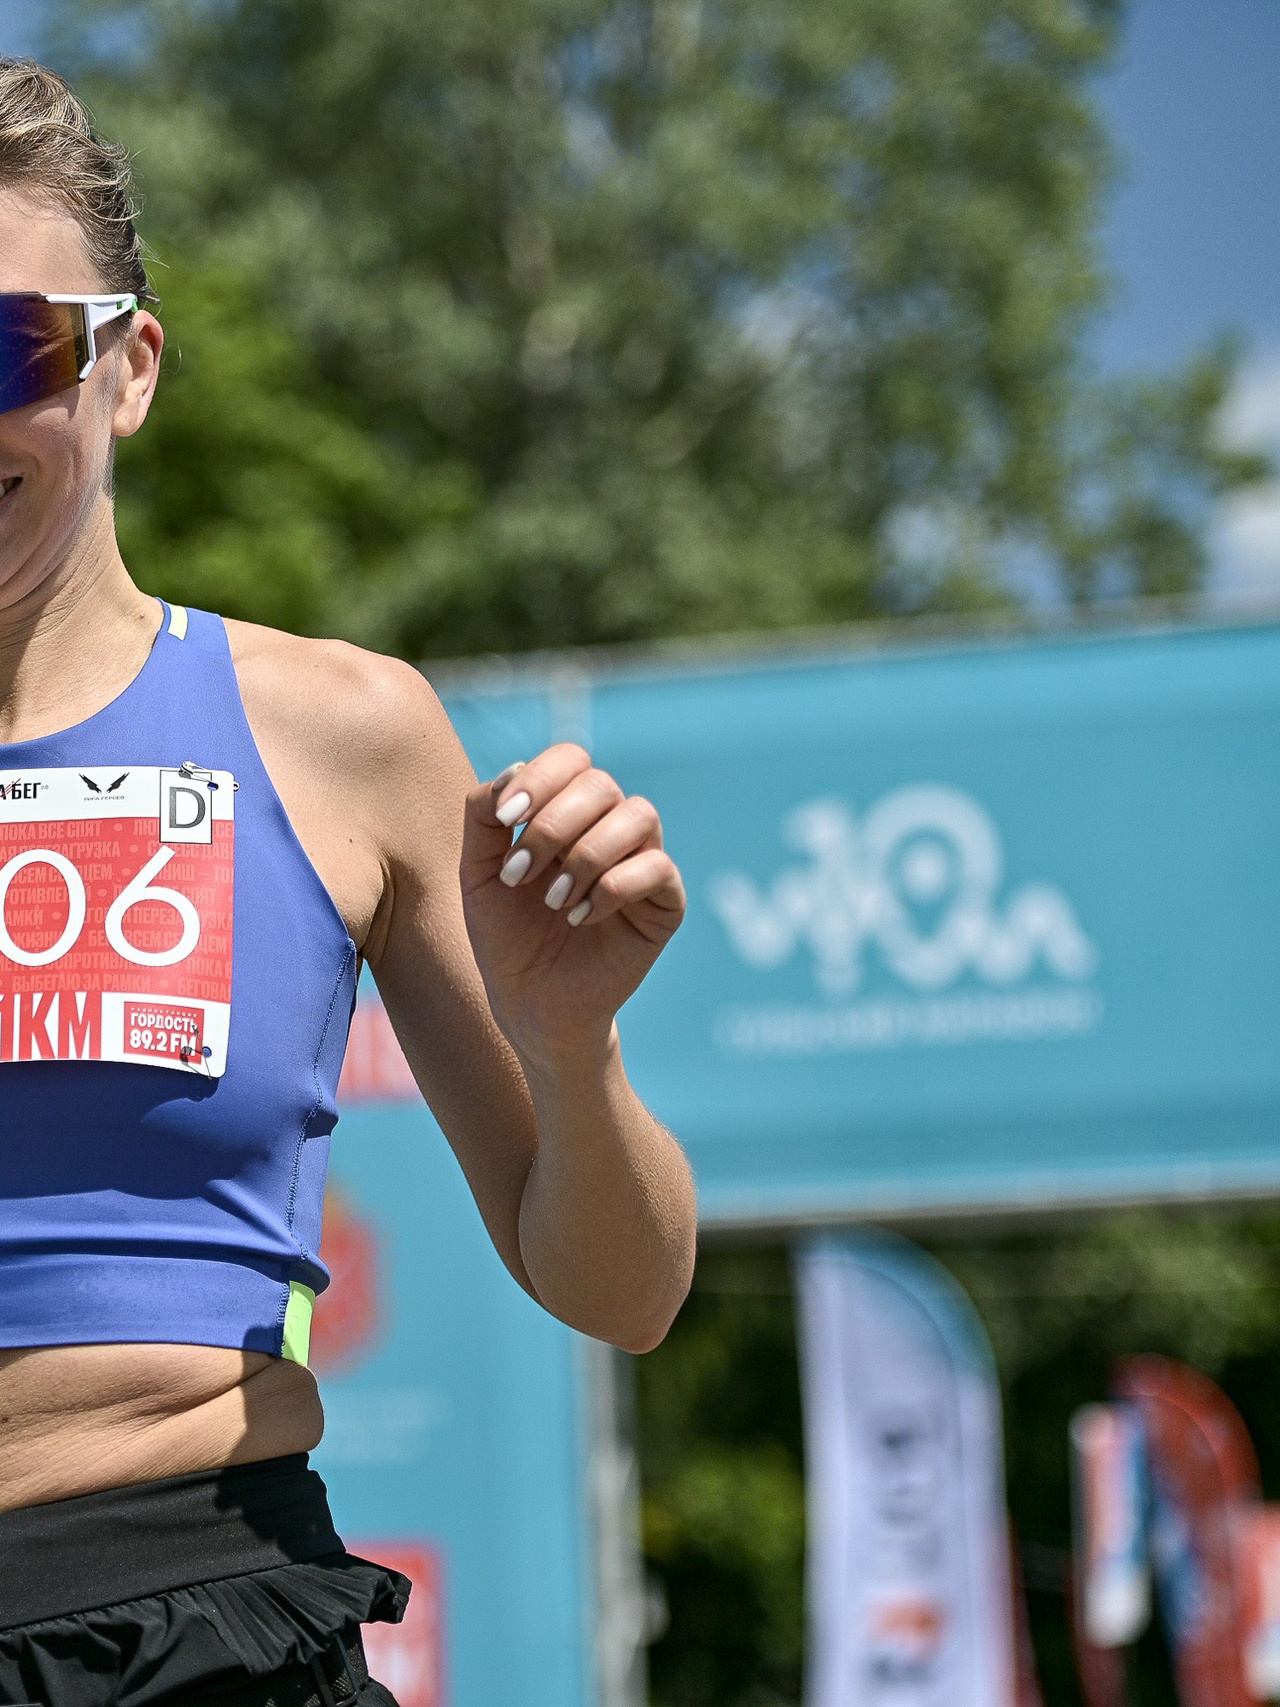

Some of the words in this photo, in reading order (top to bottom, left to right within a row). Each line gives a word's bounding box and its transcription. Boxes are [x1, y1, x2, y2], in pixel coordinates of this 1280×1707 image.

[168, 786, 206, 829] D
[0, 822, 38, 841] ПОКА
[38, 821, 65, 839] ВСЕ
[65, 820, 103, 838] СПЯТ
[12, 973, 81, 993] ВЫБЕГАЮ
[82, 973, 101, 991] ЗА
[102, 973, 152, 992] РАМКИ
[130, 1012, 198, 1034] ГОРДОСТЬ
[130, 1028, 168, 1052] 89.2
[170, 1032, 197, 1057] FM
